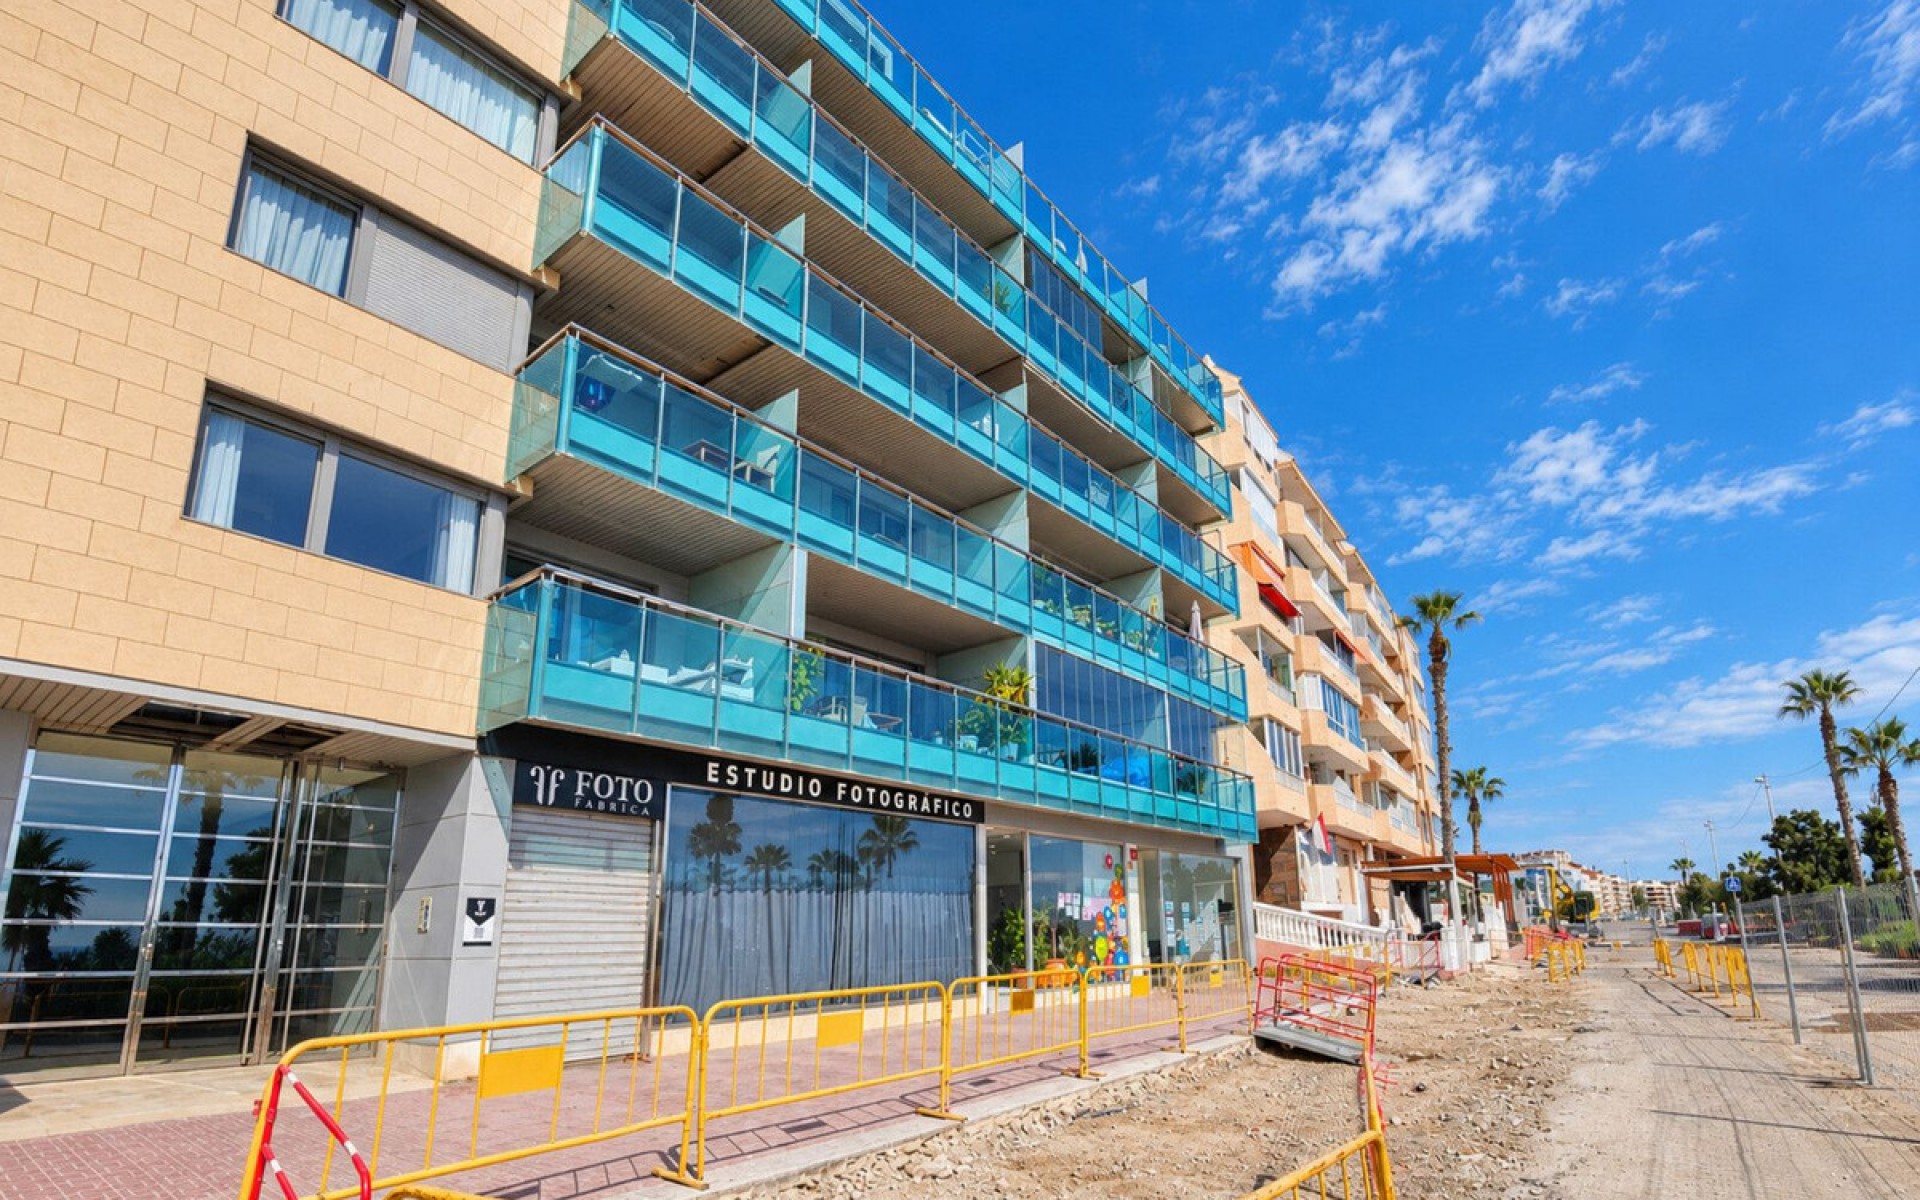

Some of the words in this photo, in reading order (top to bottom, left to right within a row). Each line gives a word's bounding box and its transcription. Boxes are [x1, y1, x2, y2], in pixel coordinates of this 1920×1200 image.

[575, 769, 654, 804] FOTO
[706, 762, 822, 797] ESTUDIO
[837, 782, 973, 818] FOTOGRÁFICO
[574, 796, 650, 816] FABRICA
